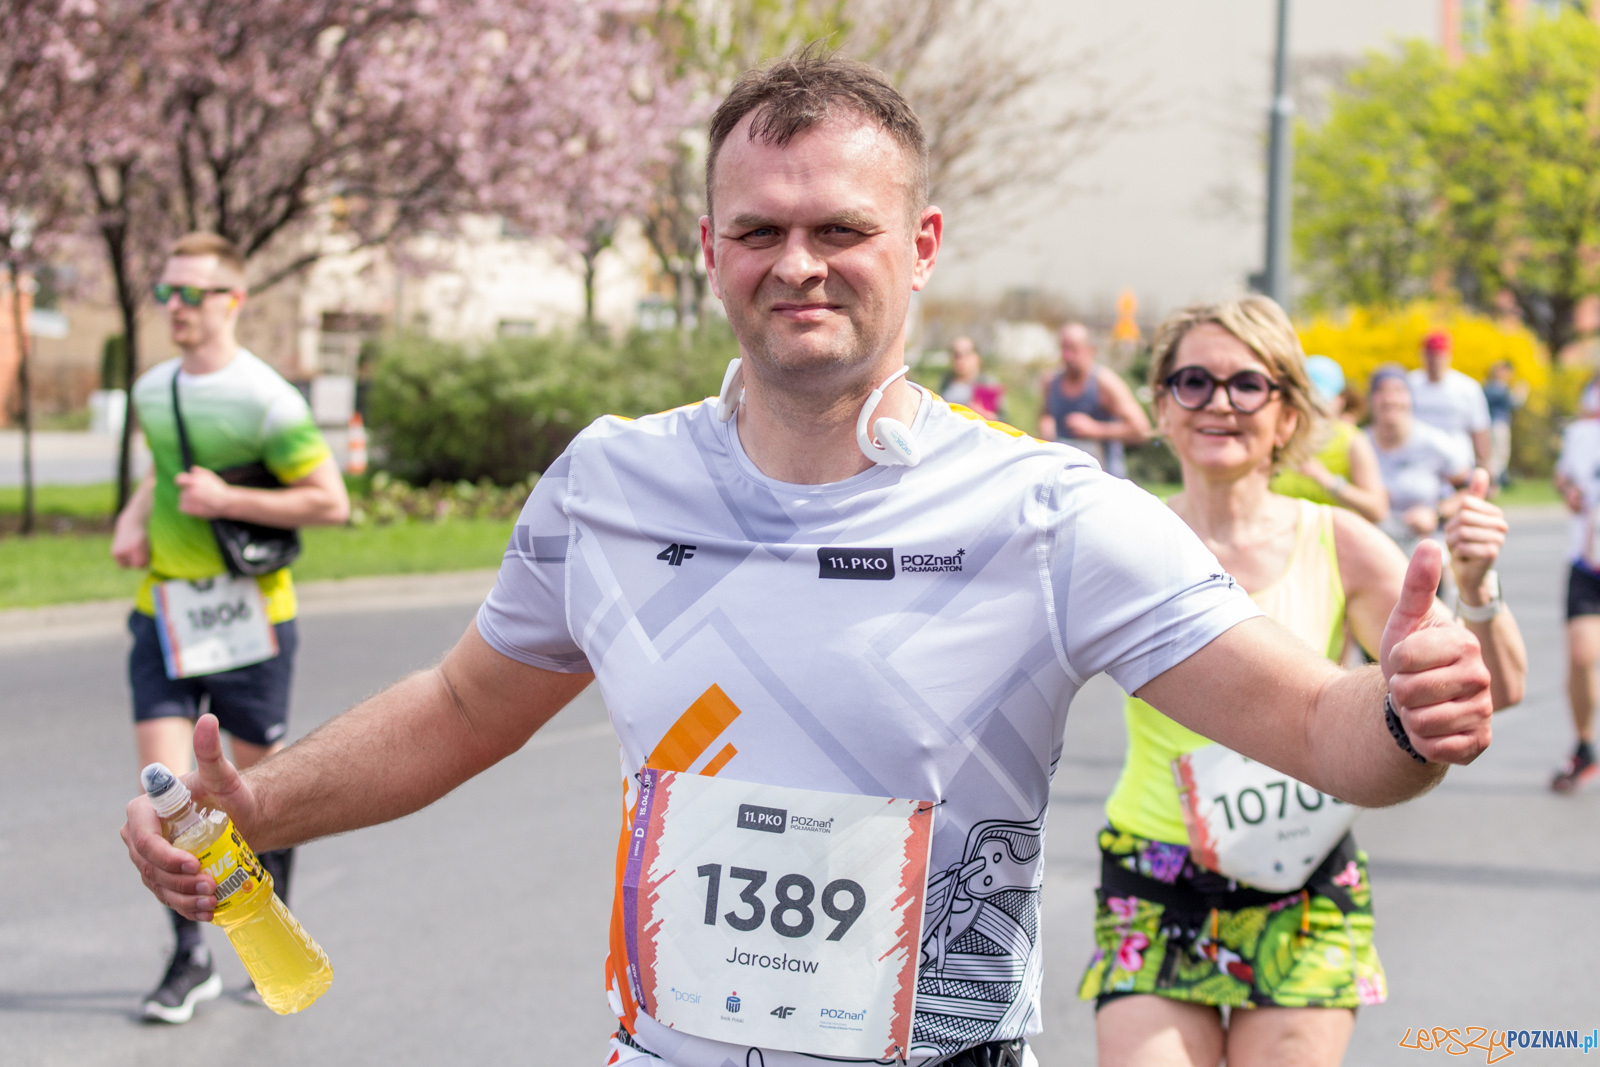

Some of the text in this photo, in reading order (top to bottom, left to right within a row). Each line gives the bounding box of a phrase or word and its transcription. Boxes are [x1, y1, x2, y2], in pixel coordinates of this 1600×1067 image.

[656, 543, 697, 566] 4F
[1213, 780, 1345, 831] 1070
[635, 828, 645, 838] D
[214, 867, 249, 902] UNIOR
[697, 863, 867, 941] 1389
[726, 946, 819, 974] Jarosław
[769, 1006, 797, 1019] 4F
